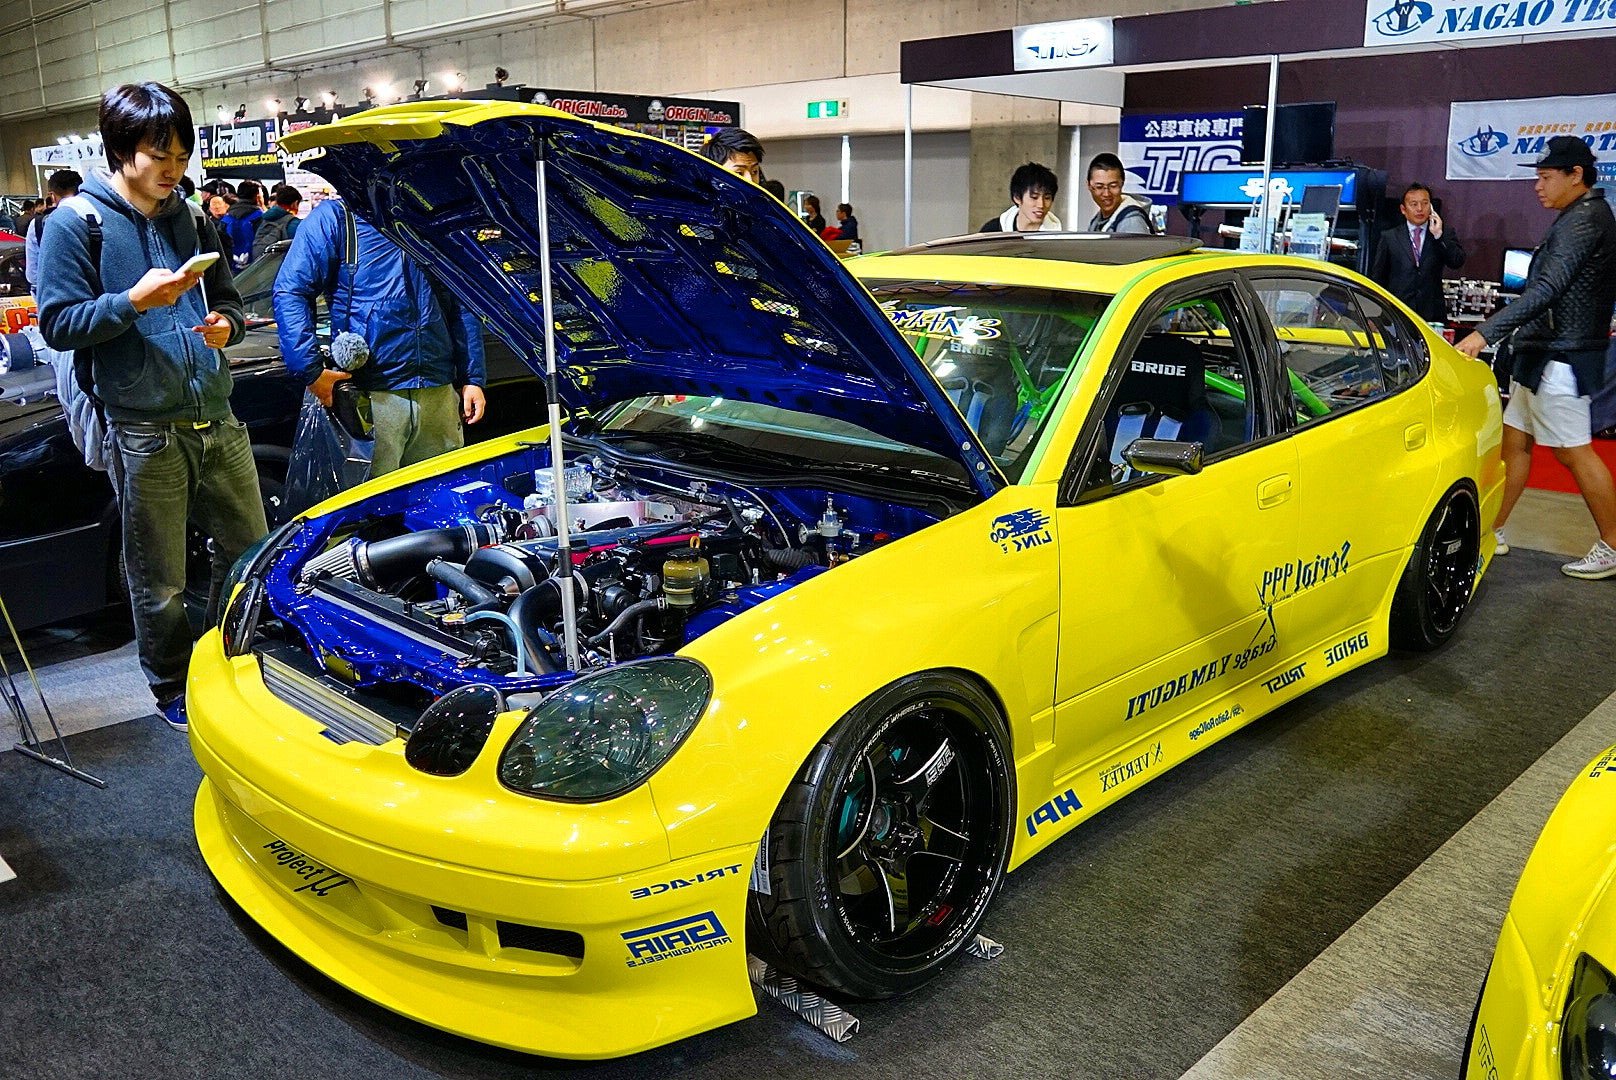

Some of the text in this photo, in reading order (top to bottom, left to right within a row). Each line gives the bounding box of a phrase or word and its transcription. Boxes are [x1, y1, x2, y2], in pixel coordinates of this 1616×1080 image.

[1436, 0, 1554, 33] NAGAO
[551, 98, 601, 116] ORIGIN
[665, 105, 709, 121] ORIGIN
[1144, 118, 1244, 138] 公認車検専門
[1517, 123, 1576, 136] PERFECT
[202, 153, 278, 168] HARDTUNEDSTORE.COM
[1131, 360, 1187, 376] BRIDE
[263, 840, 326, 880] Project
